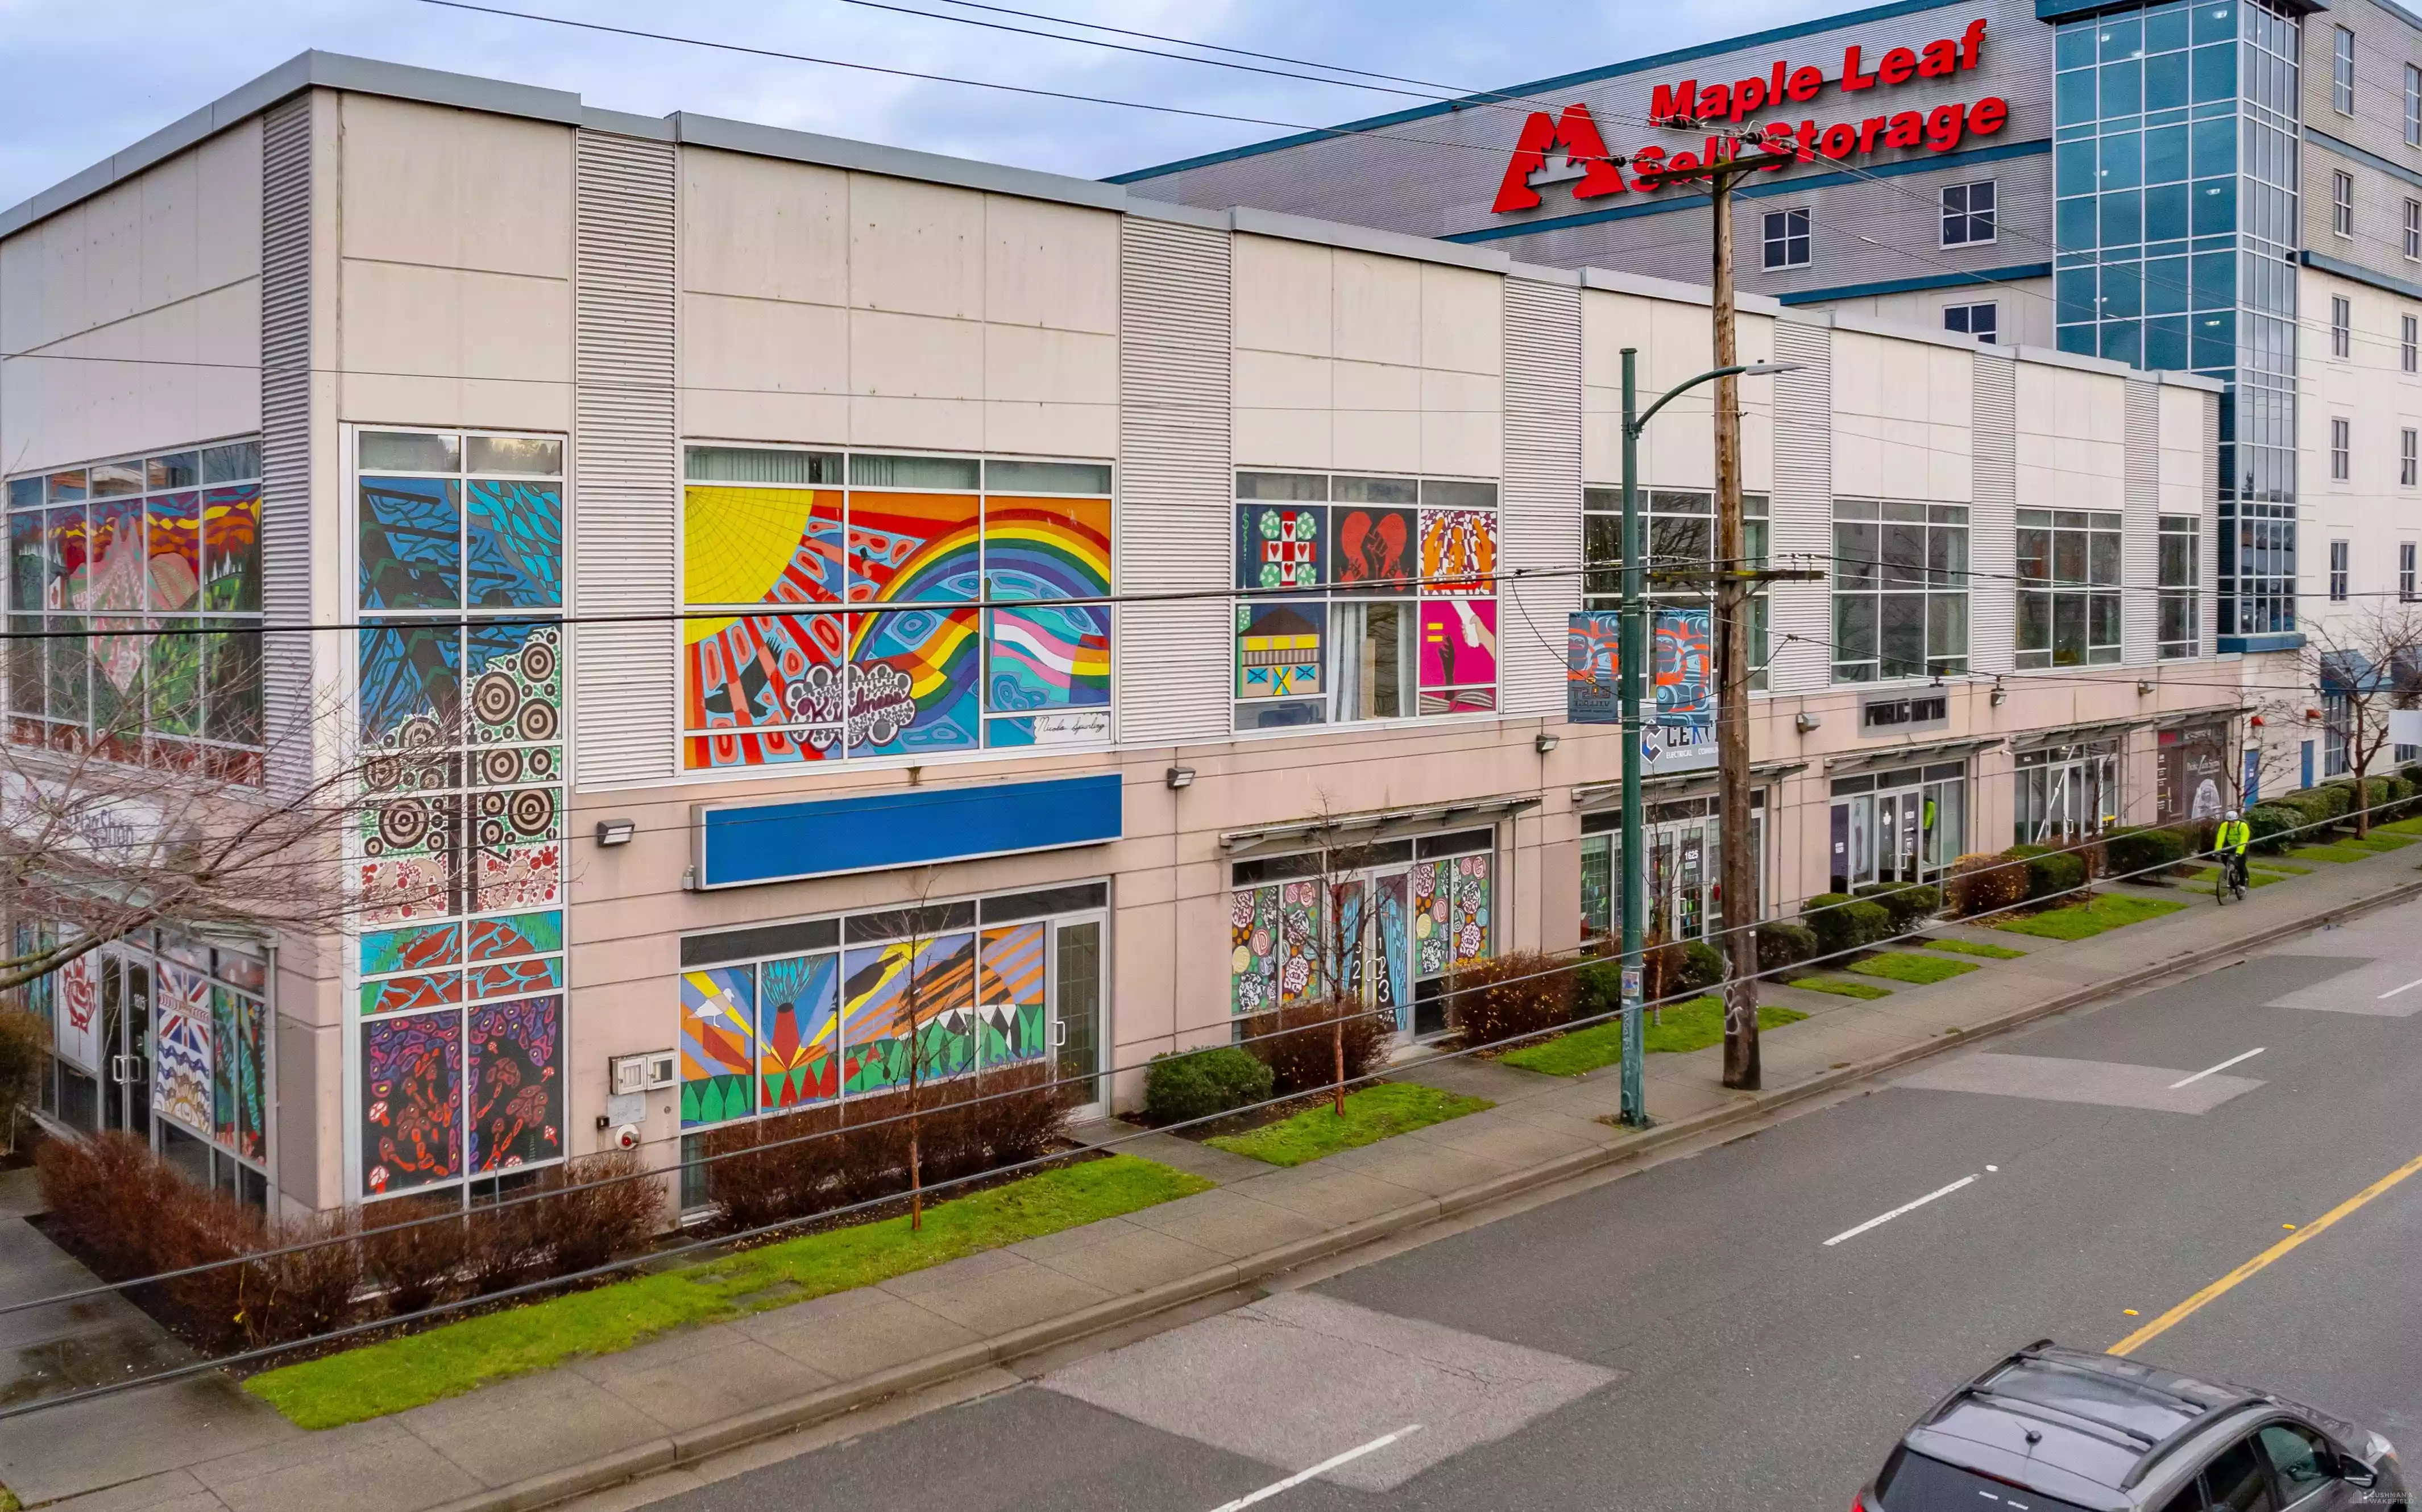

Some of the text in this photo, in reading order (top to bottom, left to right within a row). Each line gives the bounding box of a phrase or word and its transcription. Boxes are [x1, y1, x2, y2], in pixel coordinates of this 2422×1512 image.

[1649, 18, 1987, 127] Maple Leaf
[1631, 97, 2008, 192] Self Storage
